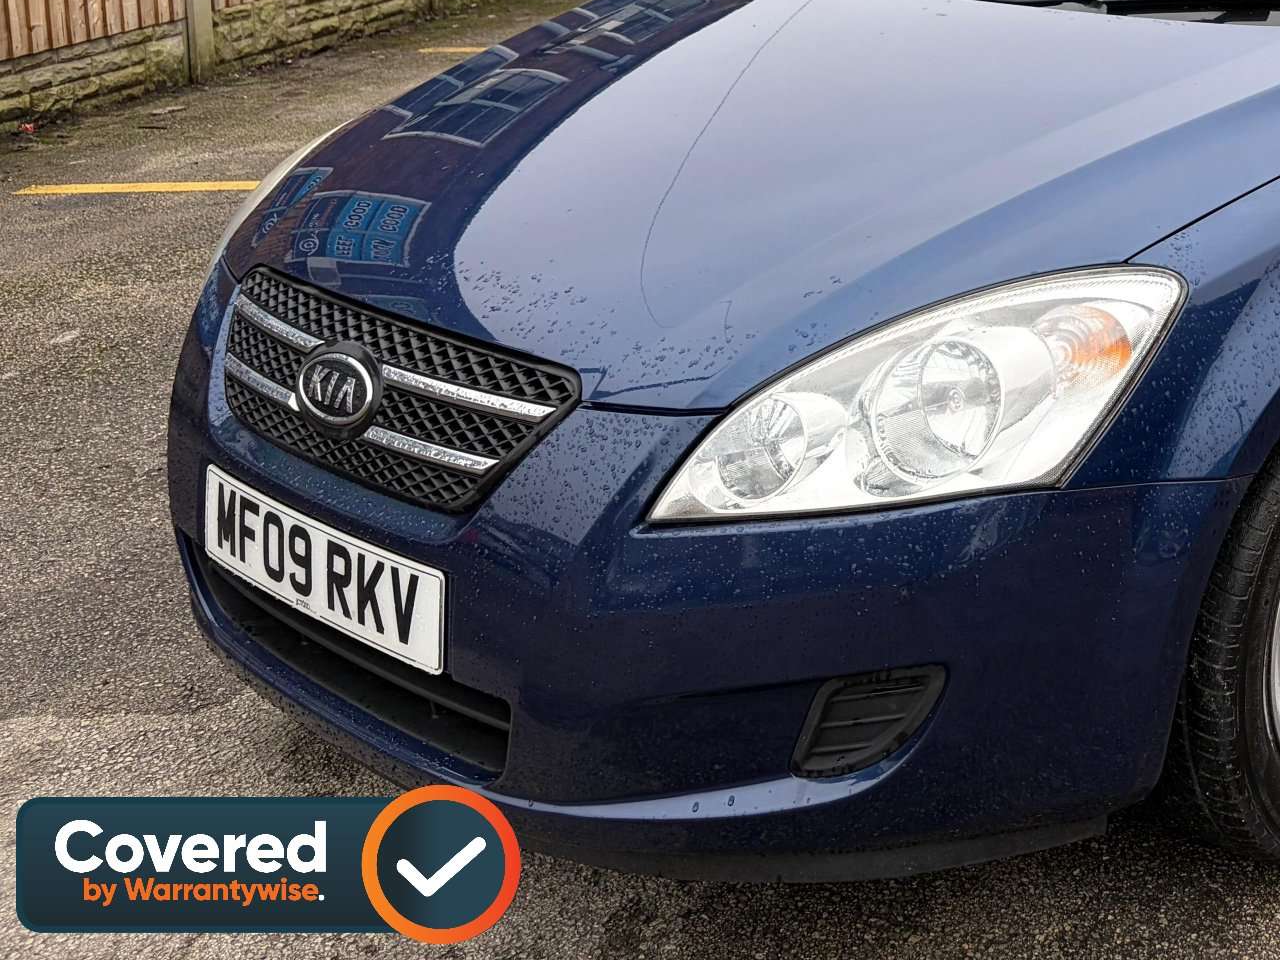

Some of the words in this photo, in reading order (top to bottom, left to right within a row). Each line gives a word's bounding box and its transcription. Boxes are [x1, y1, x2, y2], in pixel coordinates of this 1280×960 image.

[308, 363, 357, 414] KIA
[217, 481, 312, 598] MF09
[326, 539, 420, 645] RKV
